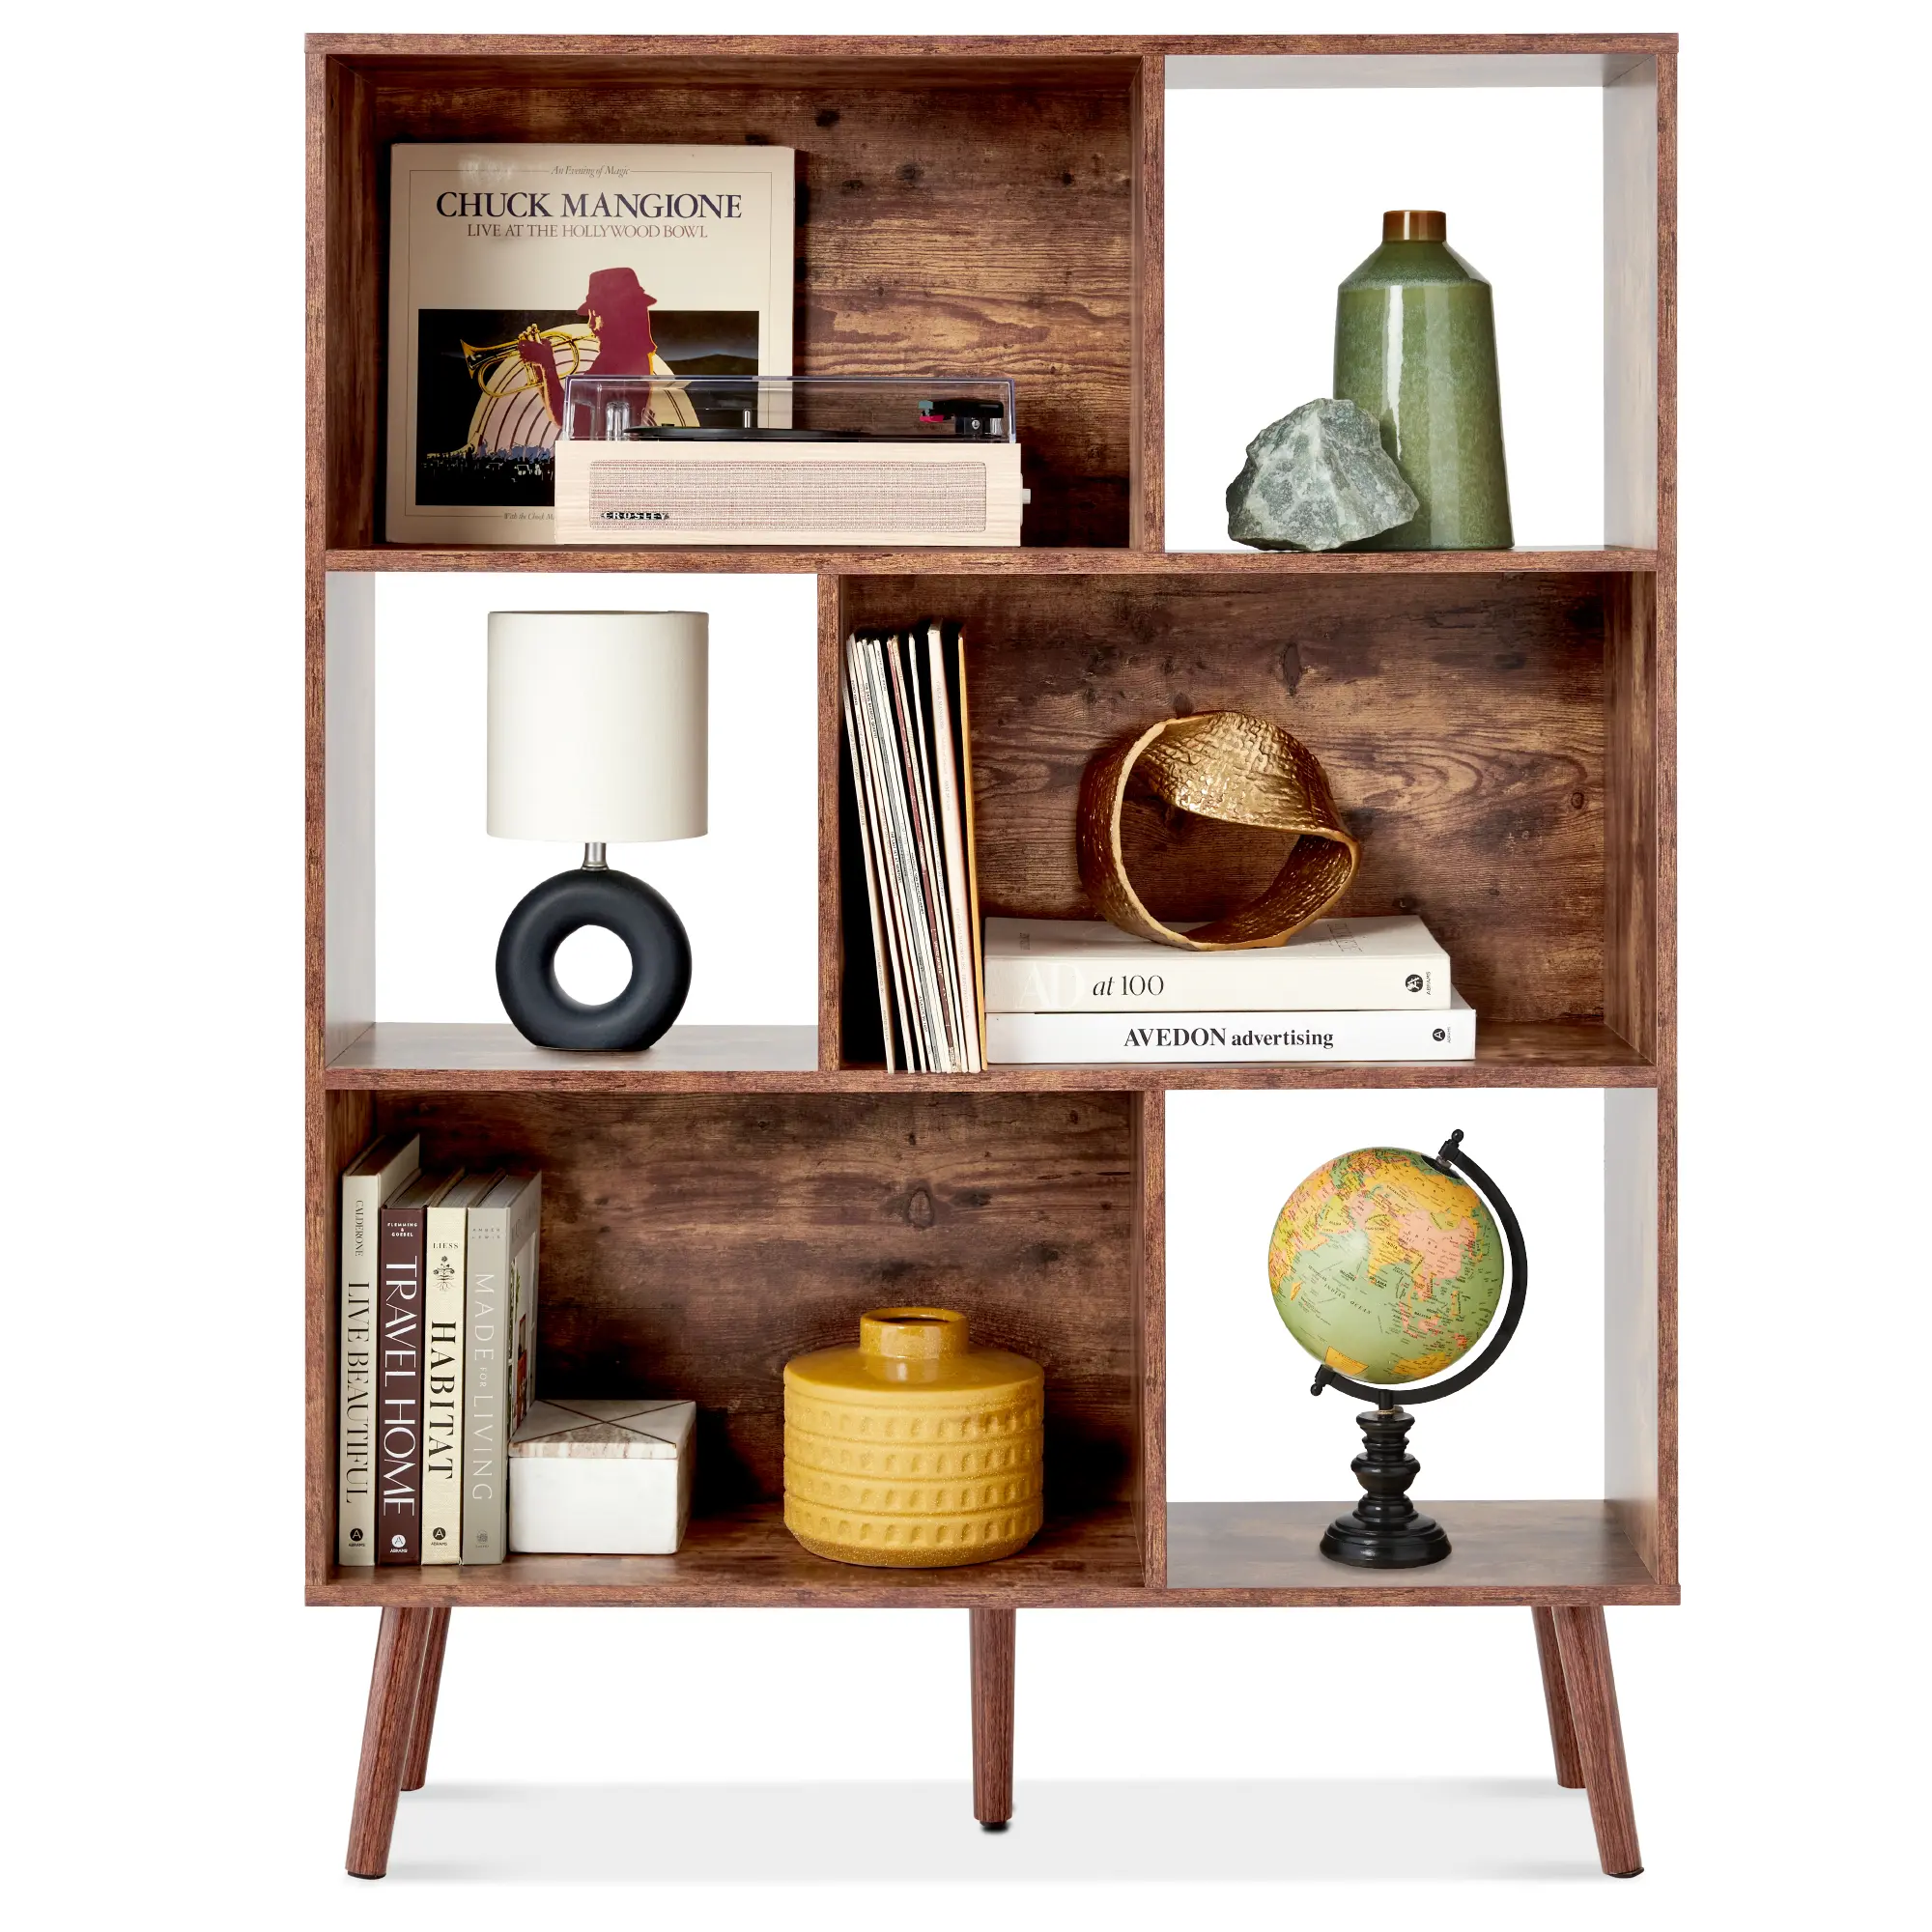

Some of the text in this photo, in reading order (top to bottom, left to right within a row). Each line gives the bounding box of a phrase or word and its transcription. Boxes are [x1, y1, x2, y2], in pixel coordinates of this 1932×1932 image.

[551, 164, 631, 179] An Evening of Magic
[437, 191, 742, 219] CHUCK MANGIONE
[468, 224, 708, 239] LIVE AT THE HOLLYWOOD BOWL
[602, 511, 668, 521] CROSLEY
[1016, 962, 1164, 1009] AD at 100
[1124, 1027, 1334, 1050] AVEDON advertising
[355, 1200, 364, 1257] CALDERONE
[346, 1282, 370, 1504] LIVE BEAUTIFUL
[384, 1256, 417, 1517] TRAVEL HOME
[428, 1321, 457, 1479] HABITAT
[472, 1274, 495, 1500] MADE FOR LIVING
